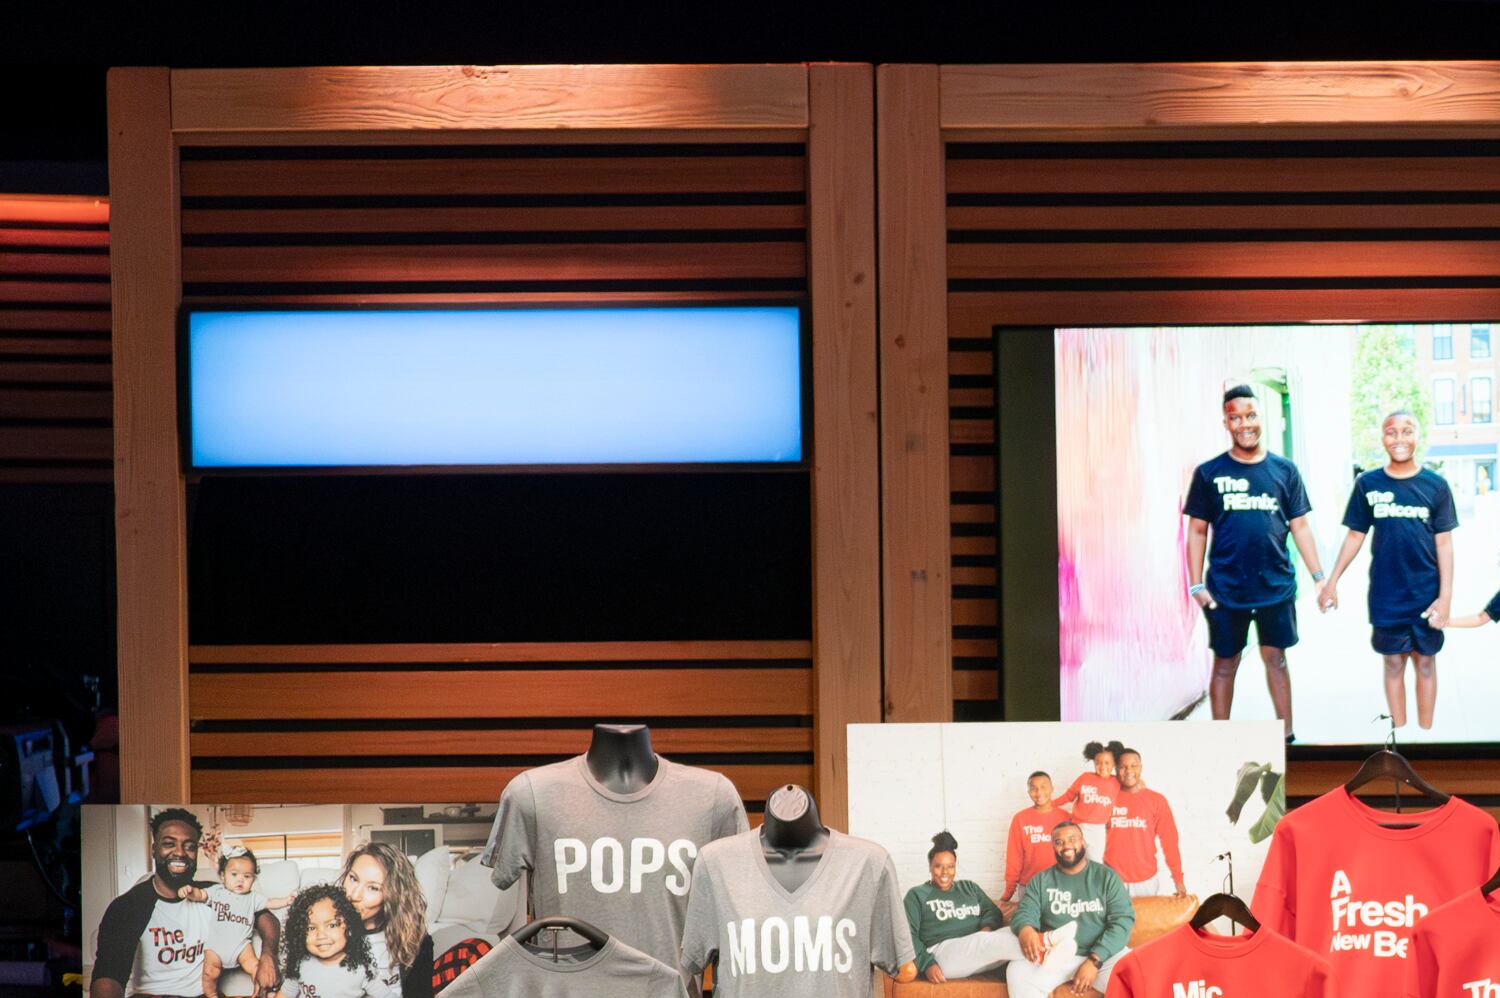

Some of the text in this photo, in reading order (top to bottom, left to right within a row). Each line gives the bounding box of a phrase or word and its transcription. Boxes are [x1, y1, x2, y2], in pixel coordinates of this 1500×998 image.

[1213, 476, 1250, 494] The
[1365, 490, 1395, 506] The
[1022, 825, 1043, 835] The
[554, 835, 698, 897] POPS
[1330, 869, 1352, 899] A
[1046, 888, 1072, 902] The
[926, 899, 954, 912] The
[1331, 894, 1429, 932] Fresh
[148, 927, 185, 947] The
[727, 914, 857, 977] MOMS
[1329, 931, 1372, 953] New
